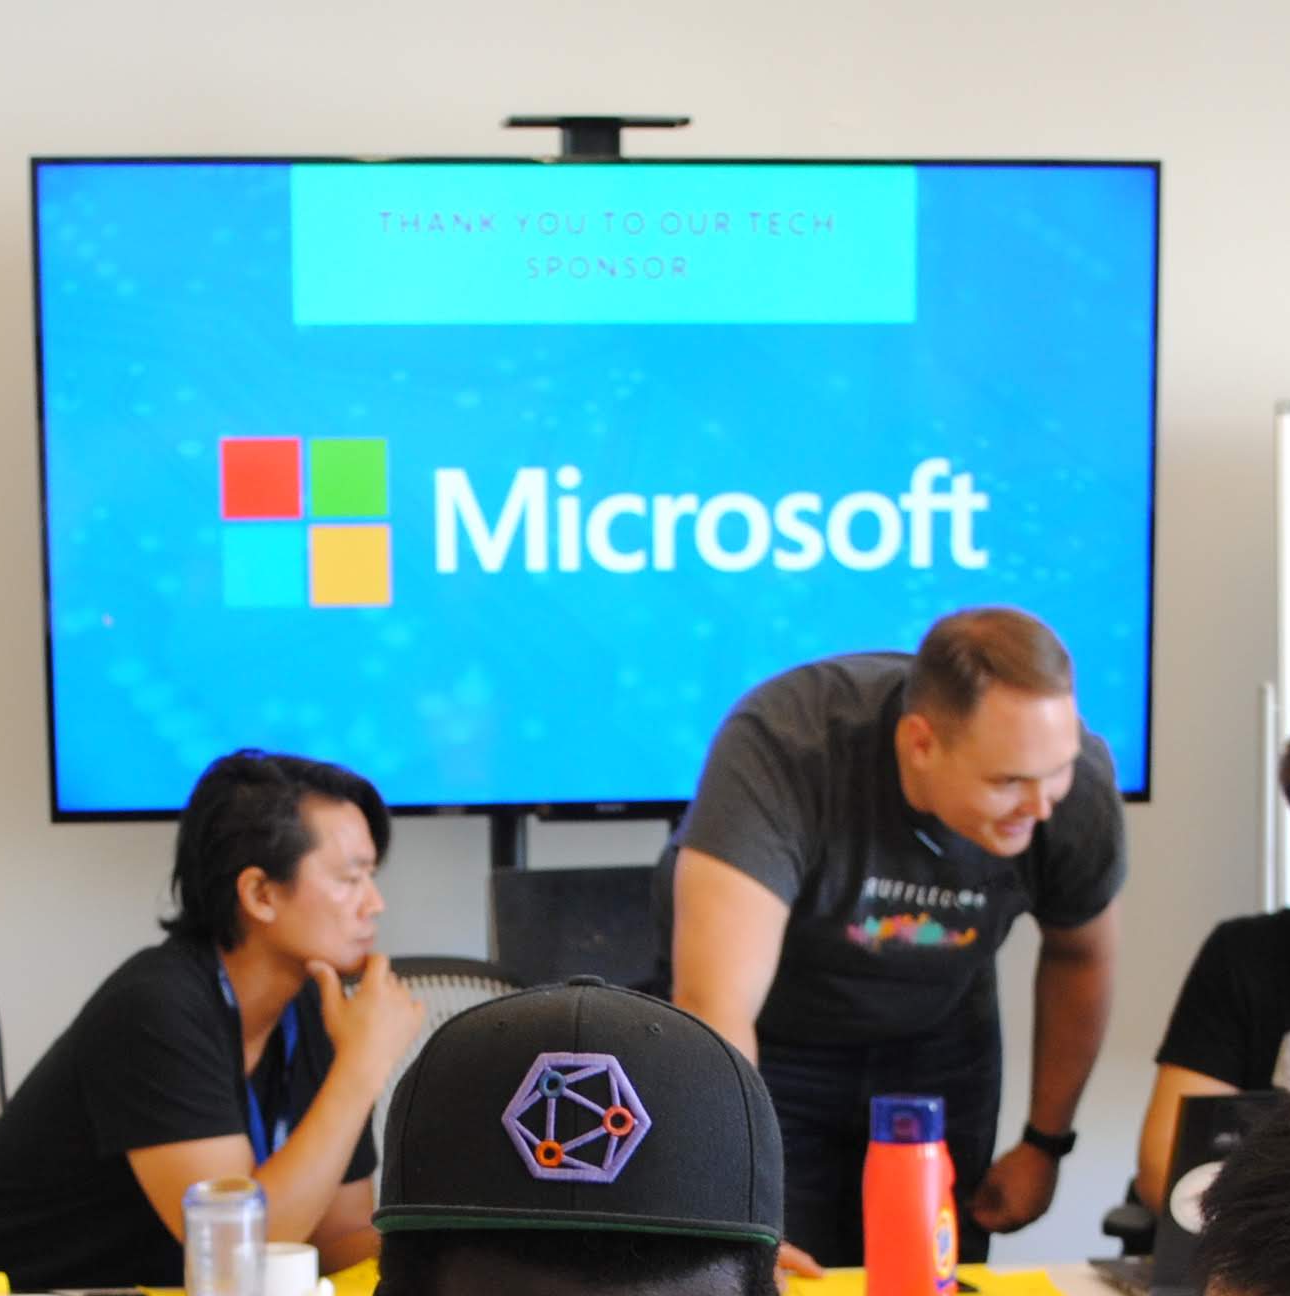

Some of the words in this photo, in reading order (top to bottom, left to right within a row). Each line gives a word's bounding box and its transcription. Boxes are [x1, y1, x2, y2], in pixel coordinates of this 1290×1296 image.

[378, 211, 497, 236] THANK
[516, 210, 588, 236] YOU
[604, 211, 647, 236] TO
[660, 211, 732, 236] OUR
[748, 211, 837, 236] TECH
[526, 256, 690, 280] SPONSOR
[434, 457, 990, 573] Microsoft
